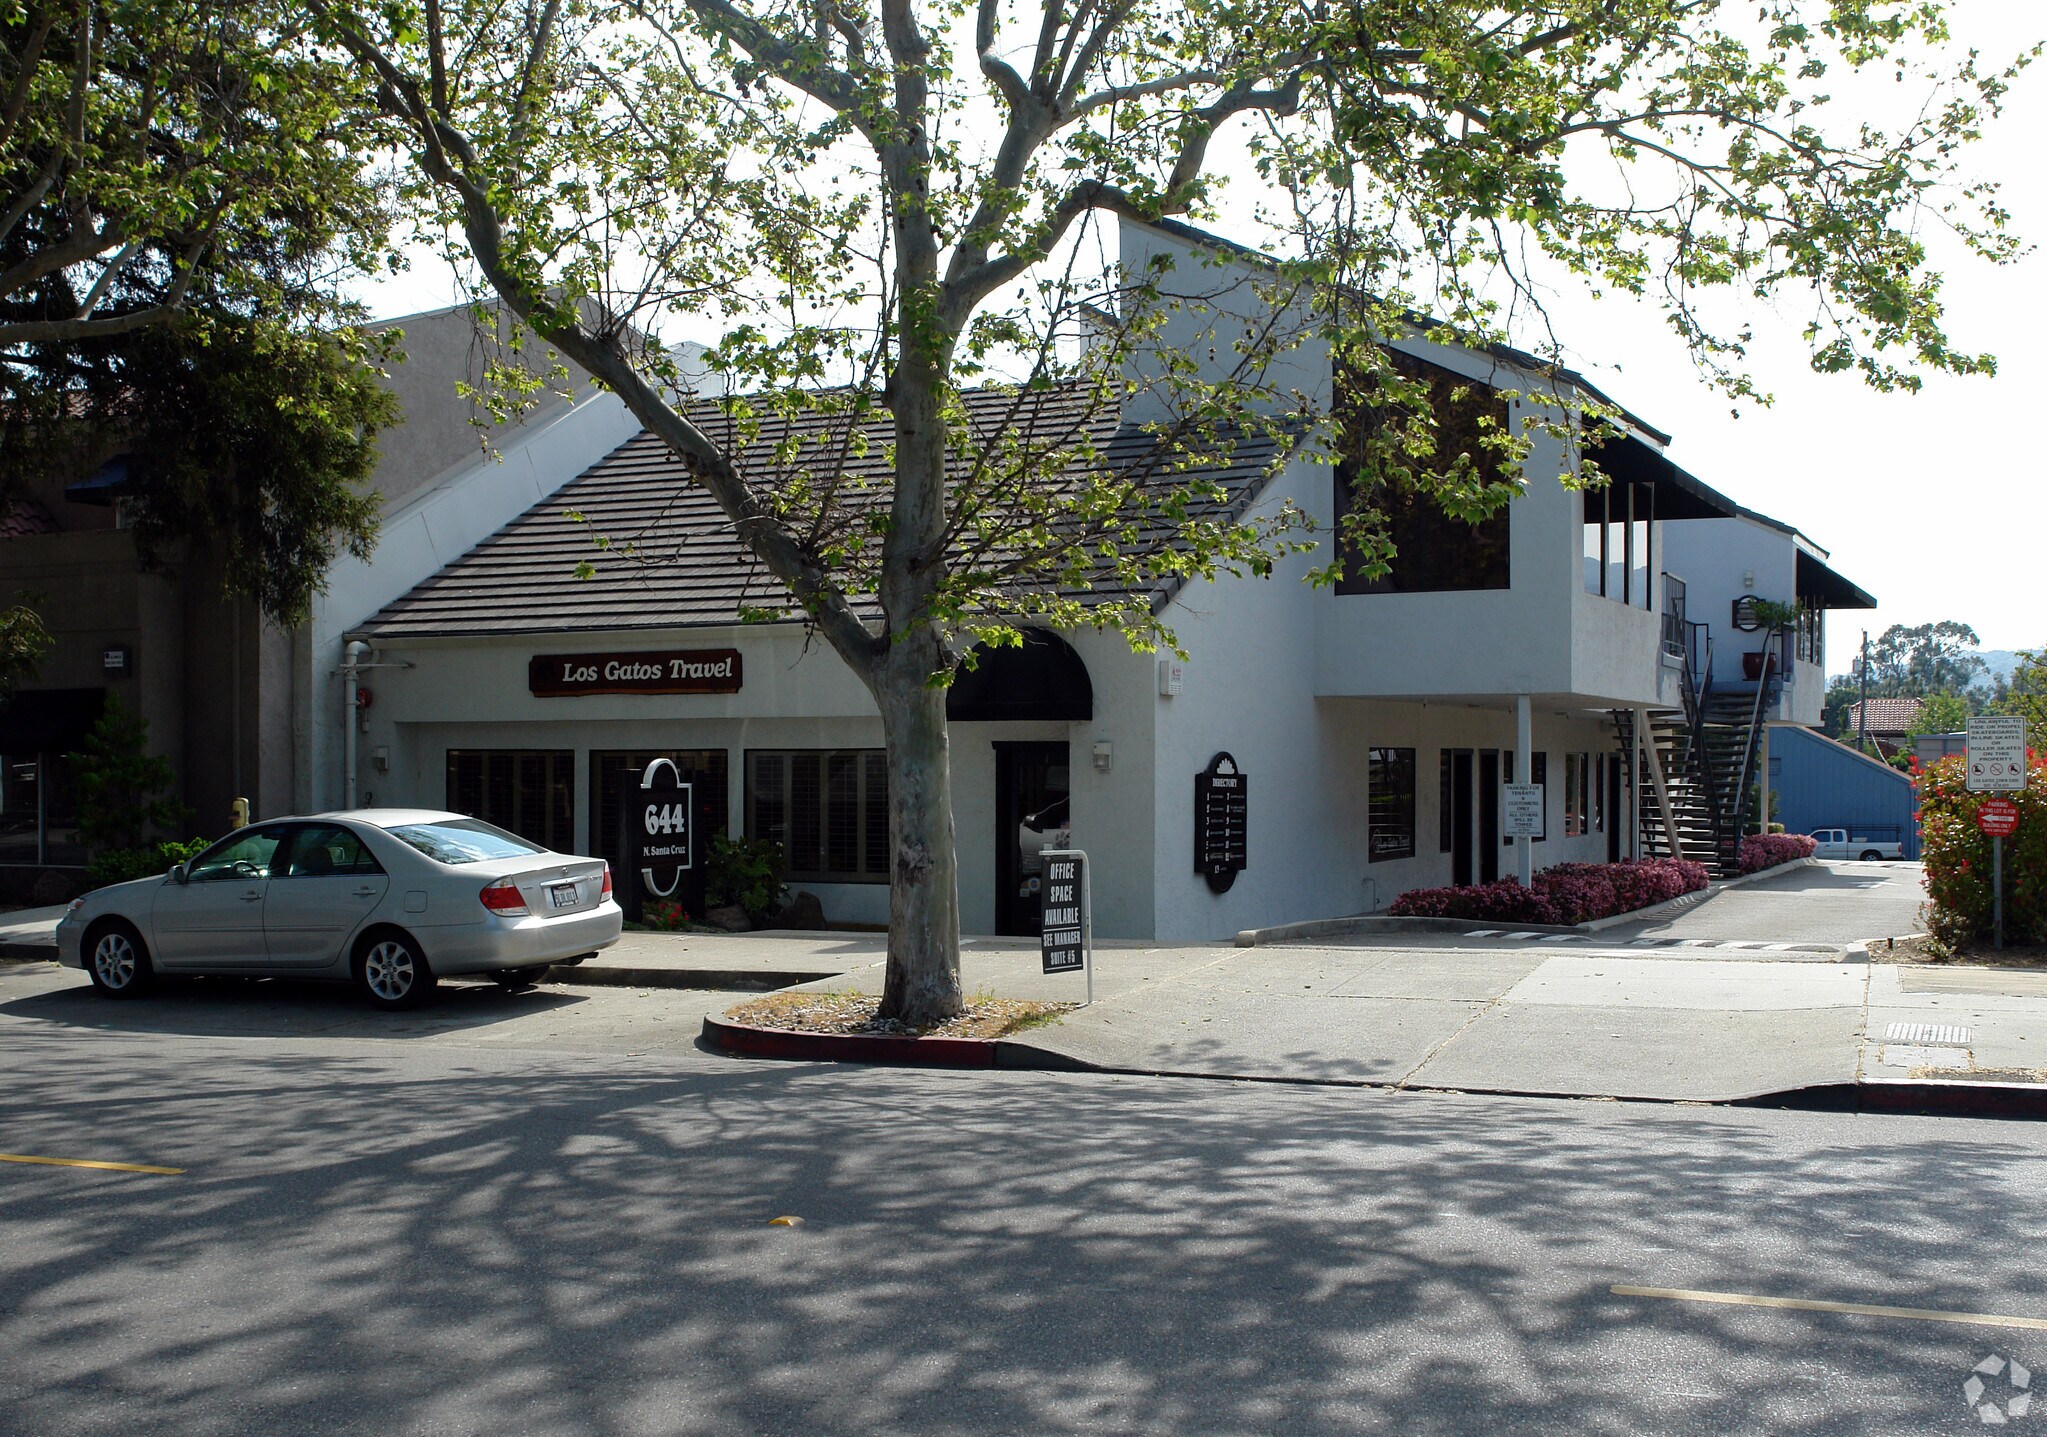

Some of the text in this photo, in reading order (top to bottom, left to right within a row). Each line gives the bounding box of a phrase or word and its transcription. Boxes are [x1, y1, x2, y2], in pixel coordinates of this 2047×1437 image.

[562, 657, 733, 682] Los Gatos Travel
[1212, 778, 1238, 788] DIRECTORY
[645, 803, 685, 835] 644
[643, 845, 686, 857] N. Santa Cruz
[1050, 862, 1075, 880] OFFICE
[1050, 885, 1073, 903] SPACE
[1044, 907, 1079, 926] AVAILABLE
[1043, 931, 1081, 947] SEE MANAGER
[1050, 950, 1075, 965] SUITE #5
